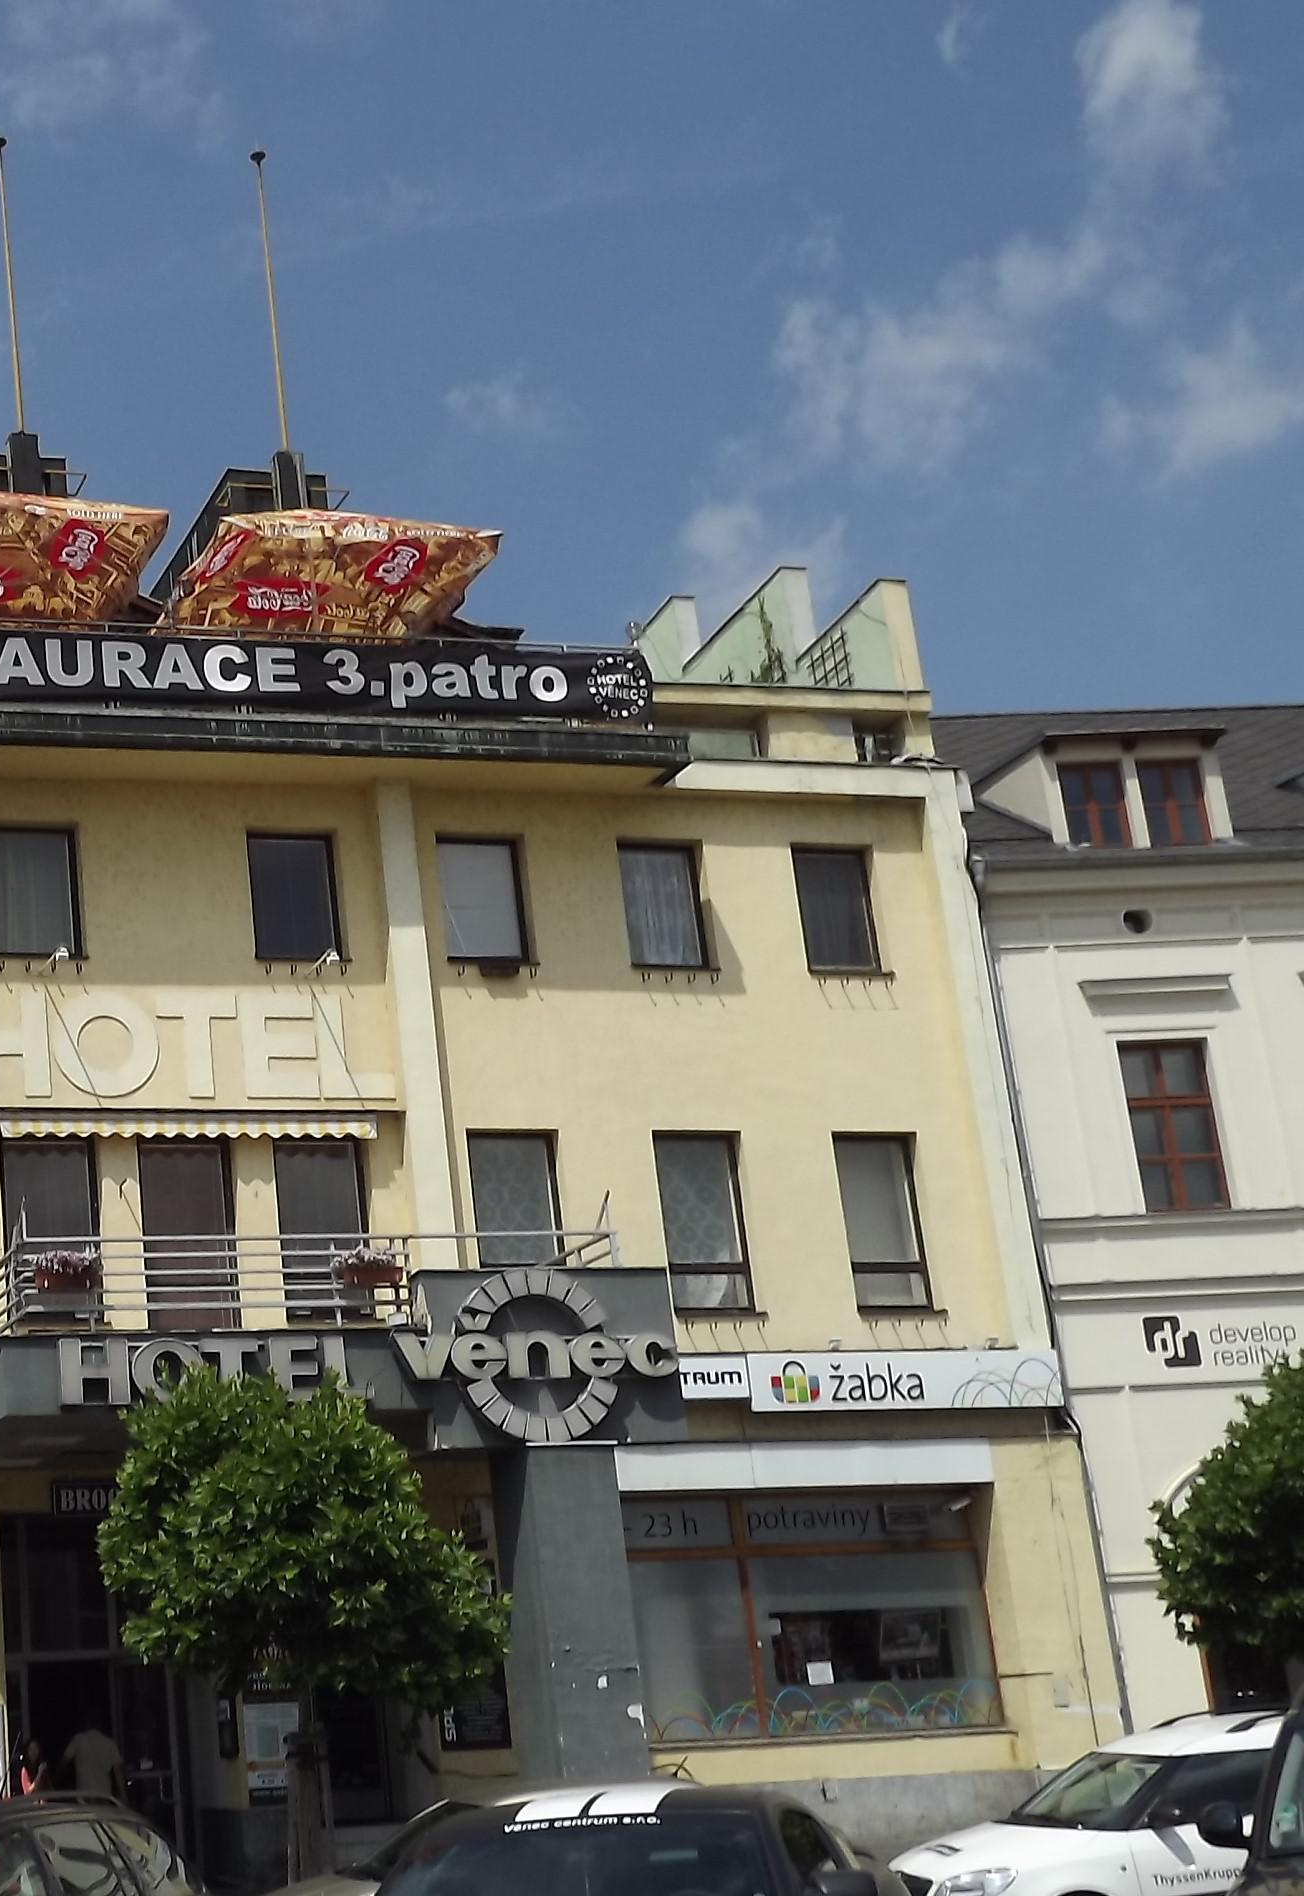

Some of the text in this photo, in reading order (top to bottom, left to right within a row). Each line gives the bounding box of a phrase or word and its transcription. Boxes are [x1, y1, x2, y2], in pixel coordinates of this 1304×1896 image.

[323, 649, 569, 709] 3.patro
[597, 674, 638, 687] HOTEL
[1209, 1321, 1296, 1347] develop
[1213, 1344, 1280, 1368] reality
[57, 1335, 377, 1407] HOTEL
[828, 1362, 925, 1402] žabka
[645, 1513, 672, 1538] 23
[682, 1510, 697, 1536] h
[746, 1504, 871, 1537] potraviny
[1152, 1867, 1242, 1888] ThyssenKrupp
